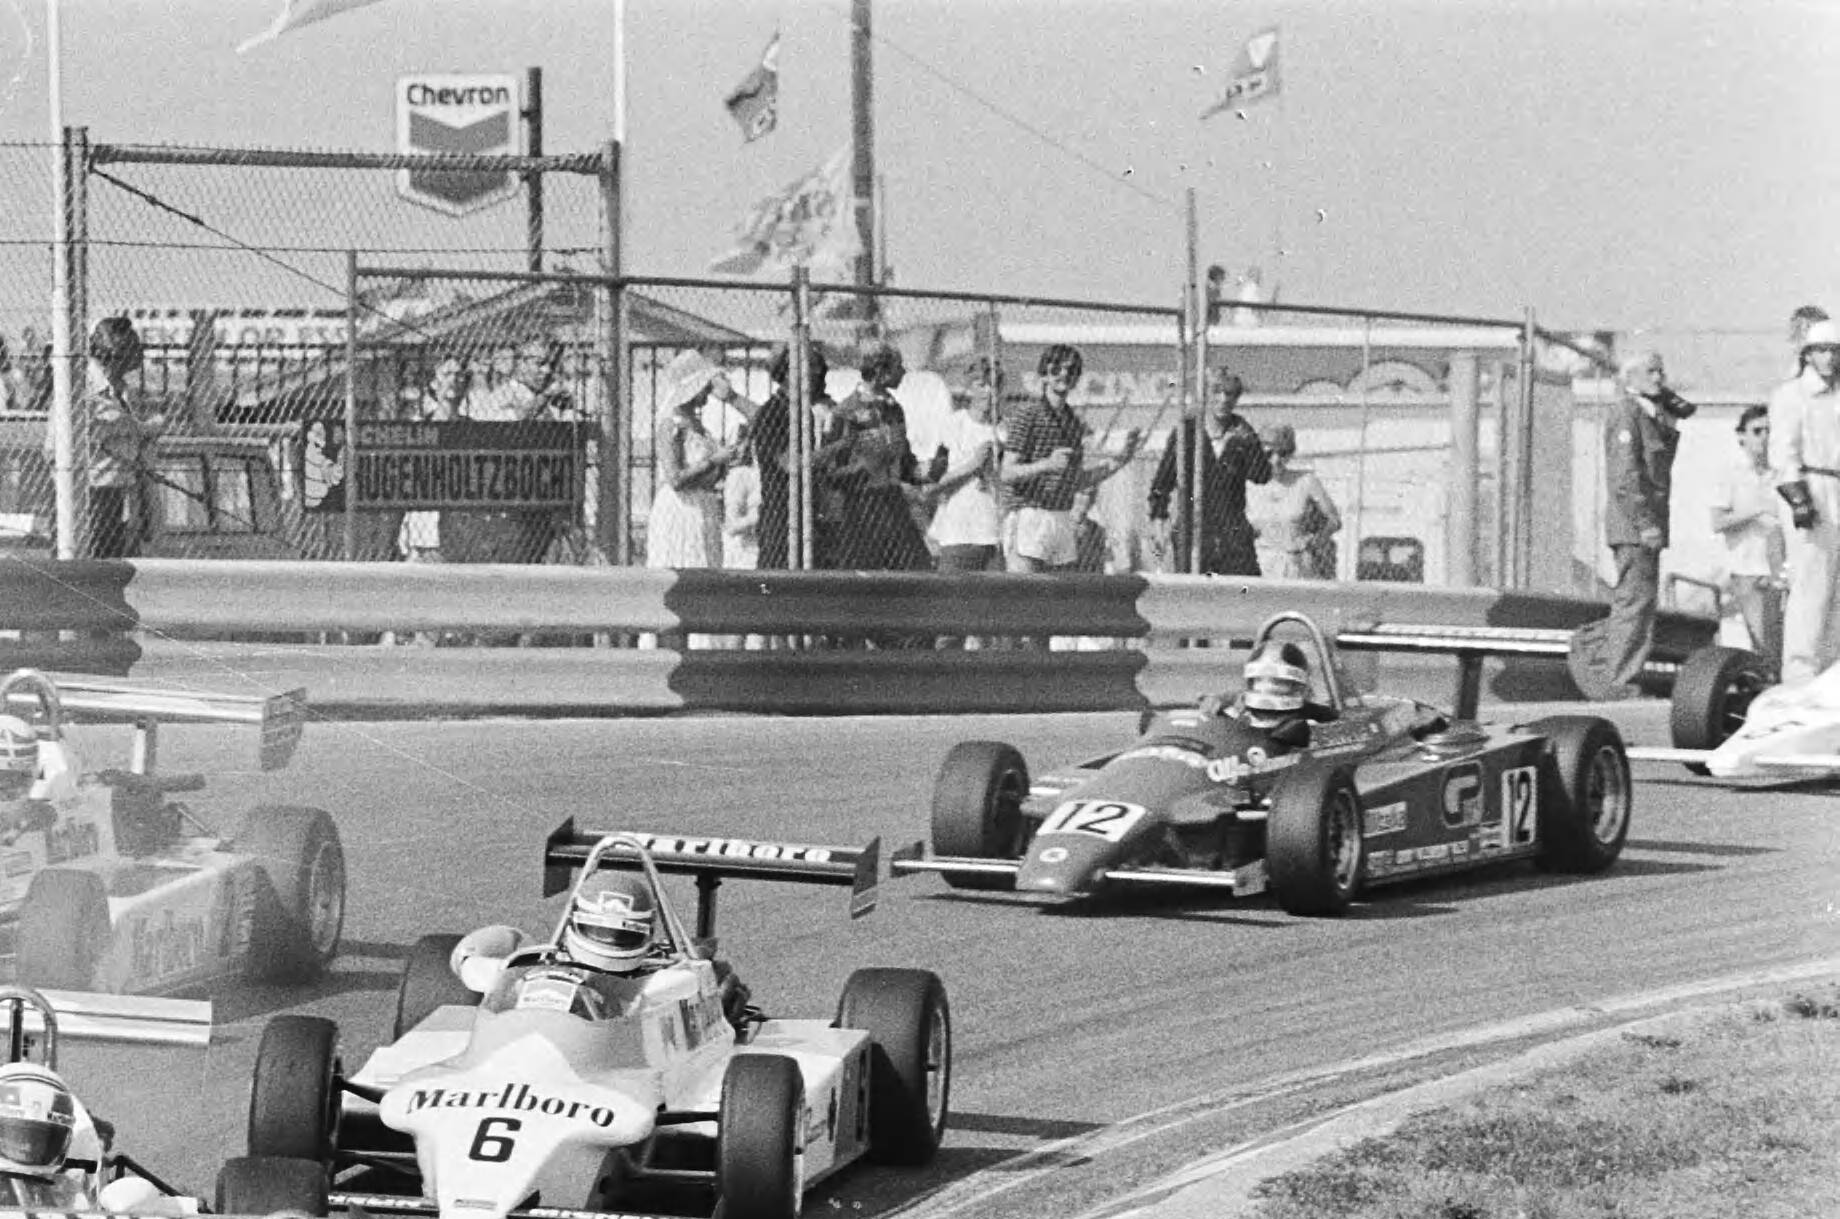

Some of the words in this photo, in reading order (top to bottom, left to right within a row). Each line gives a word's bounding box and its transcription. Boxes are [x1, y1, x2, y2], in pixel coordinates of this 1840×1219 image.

[407, 83, 509, 105] Chevron
[333, 425, 439, 445] MCHELIN
[1055, 803, 1129, 835] 12
[1508, 771, 1531, 843] 12
[407, 1083, 615, 1127] Marlboro
[469, 1117, 522, 1162] 6
